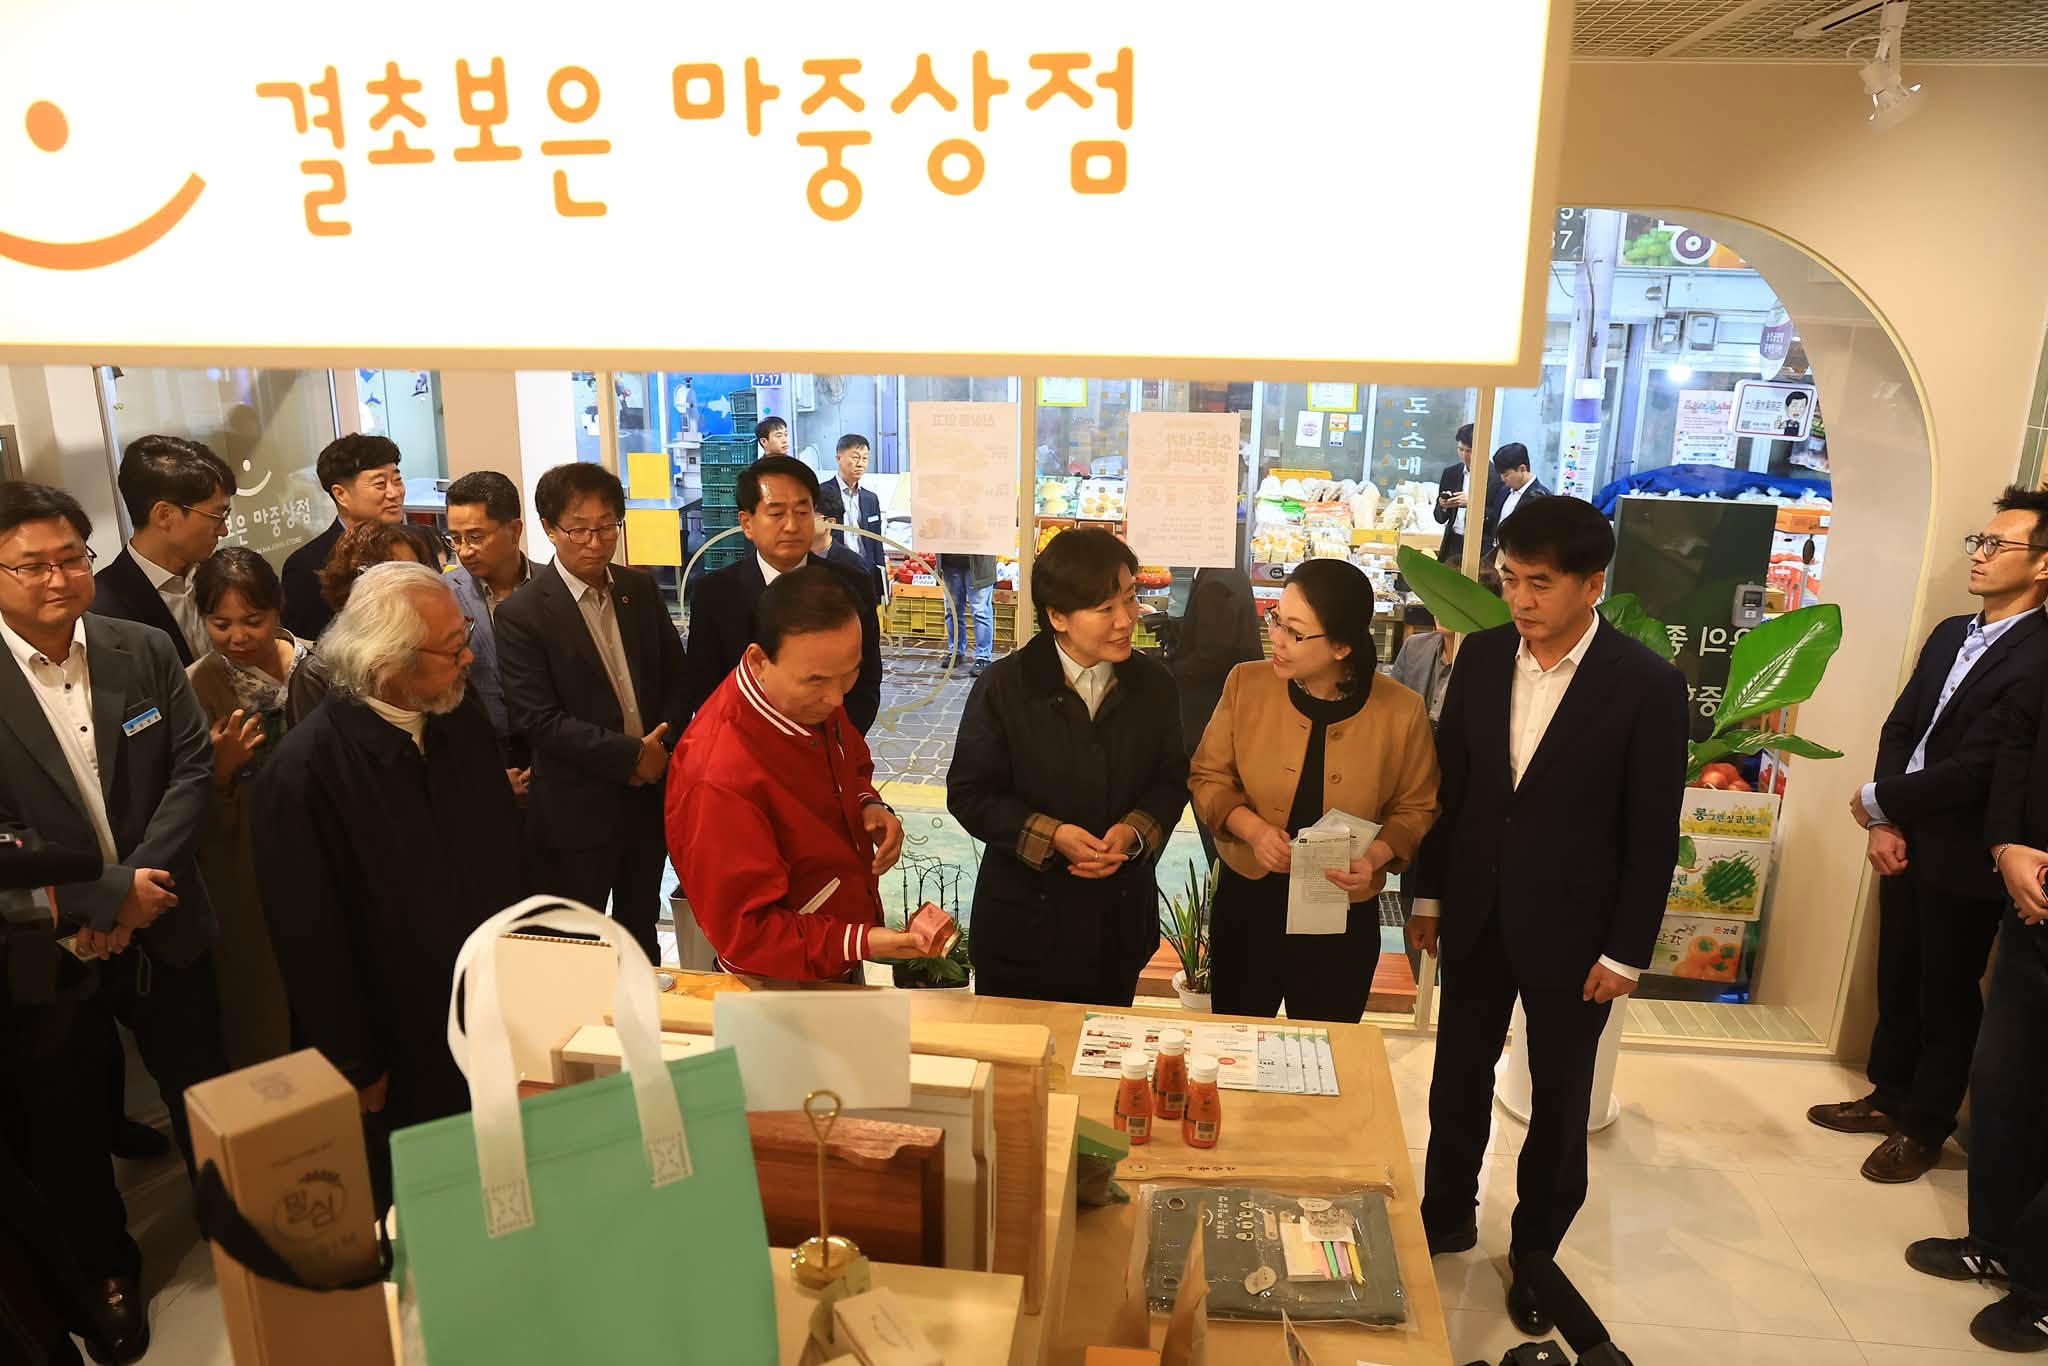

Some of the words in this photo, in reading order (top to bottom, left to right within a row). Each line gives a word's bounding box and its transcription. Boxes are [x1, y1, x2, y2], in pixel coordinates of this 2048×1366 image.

[256, 55, 612, 237] 결초보은
[672, 47, 1135, 222] 마중상점
[253, 497, 311, 537] 마중상점
